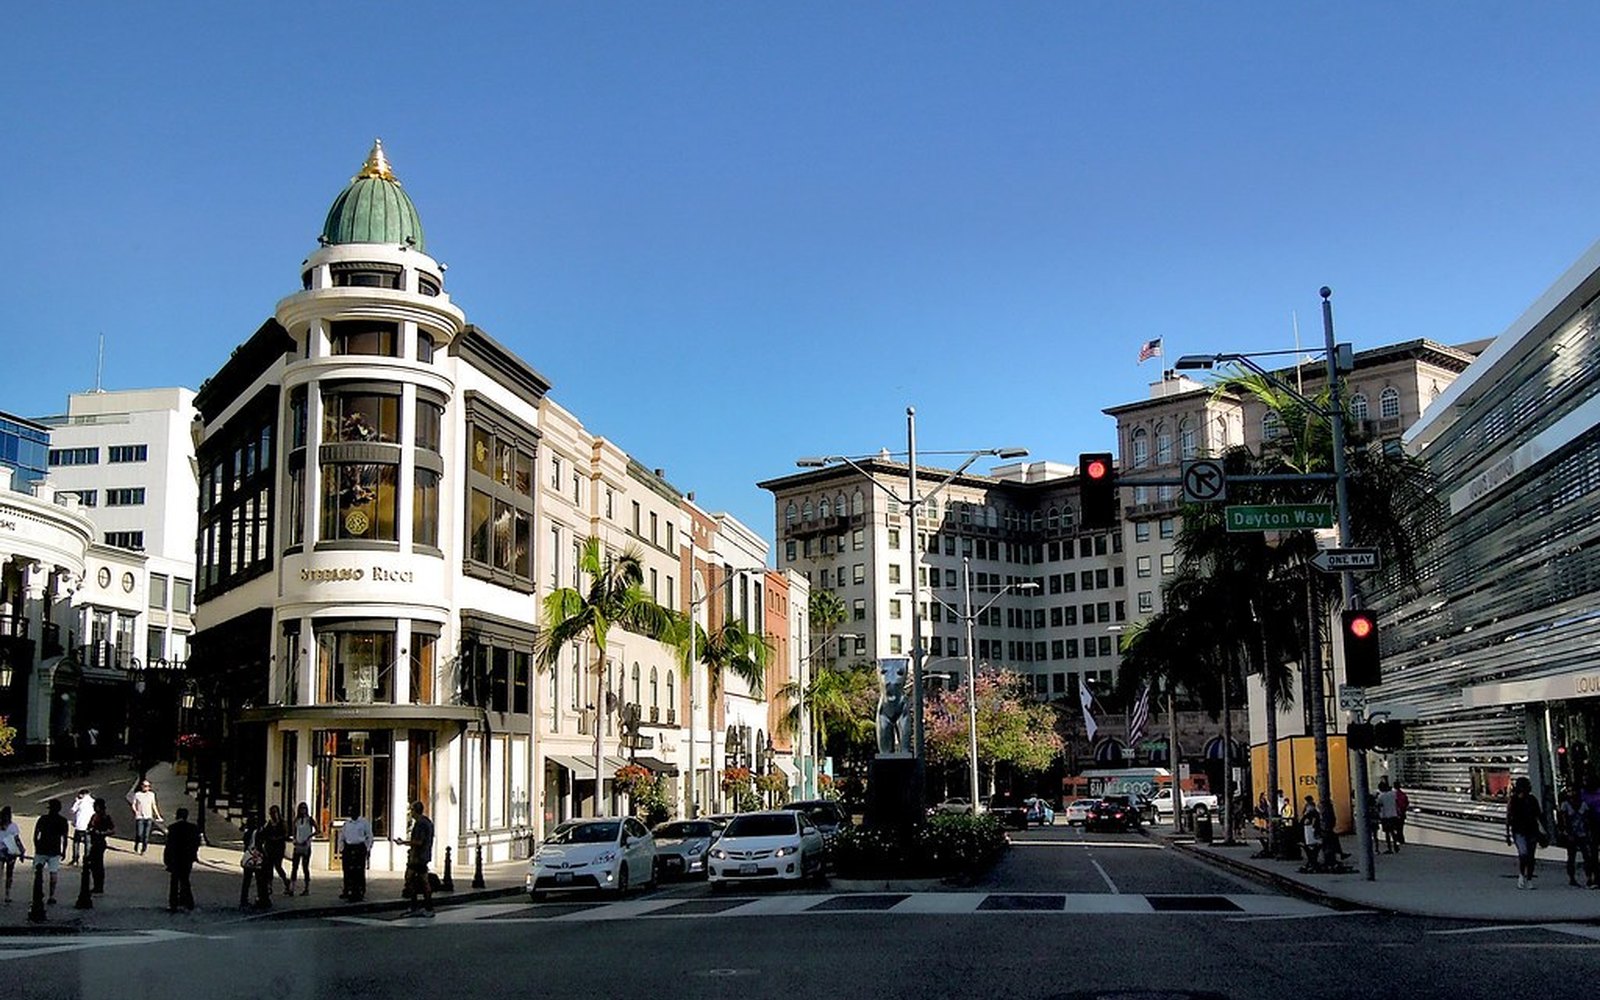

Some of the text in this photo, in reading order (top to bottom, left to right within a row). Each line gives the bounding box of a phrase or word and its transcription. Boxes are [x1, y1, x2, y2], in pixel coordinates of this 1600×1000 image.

[1234, 510, 1326, 527] Dayton Way
[1328, 554, 1373, 565] ONE WAY
